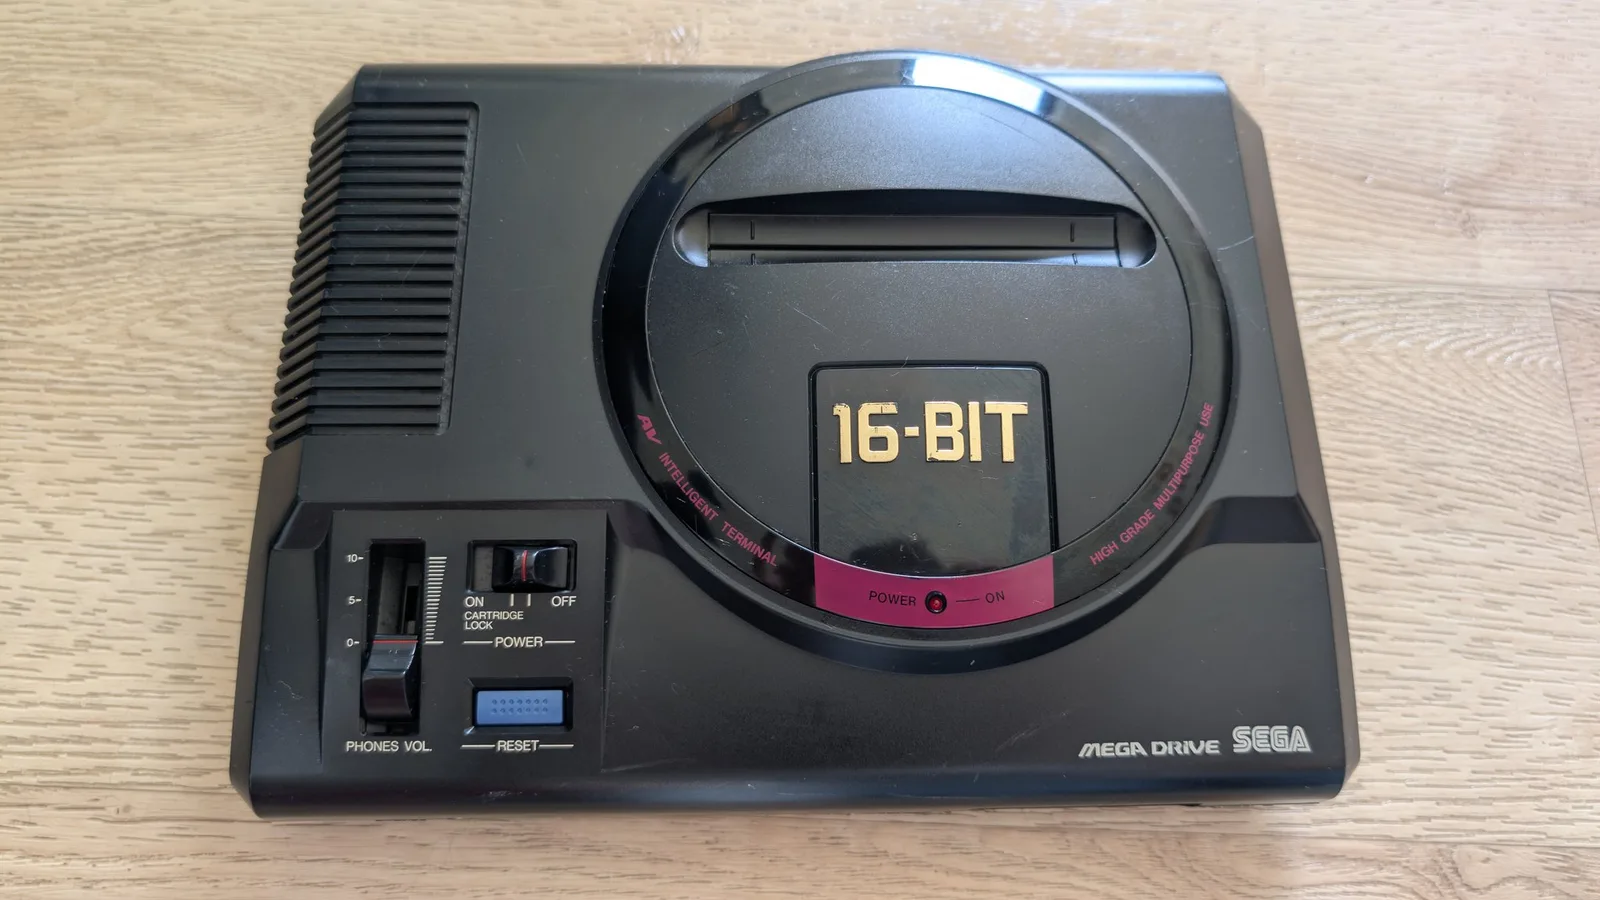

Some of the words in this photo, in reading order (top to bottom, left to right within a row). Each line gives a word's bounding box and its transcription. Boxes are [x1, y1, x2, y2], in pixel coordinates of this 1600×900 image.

[833, 401, 1028, 464] 16-BIT
[637, 414, 662, 445] AV
[658, 452, 719, 521] INTELLIGENT
[721, 521, 777, 566] TERMINAL
[1089, 541, 1119, 566] HIGH
[1119, 508, 1155, 544] GRADE
[1153, 430, 1205, 511] MULTIPURPOSE
[1199, 402, 1214, 427] USE
[464, 597, 484, 607] ON
[551, 596, 576, 607] OFF
[869, 590, 917, 606] POWER
[985, 591, 1005, 604] ON
[464, 611, 524, 621] CARTRIDGE
[465, 621, 493, 630] LOCK
[495, 636, 543, 648] POWER
[1232, 725, 1311, 753] SEGA
[346, 741, 399, 752] PHONES
[404, 741, 432, 752] VOL.
[496, 740, 540, 752] RESET
[1078, 741, 1148, 757] MEGA
[1151, 740, 1220, 756] DRIVE
